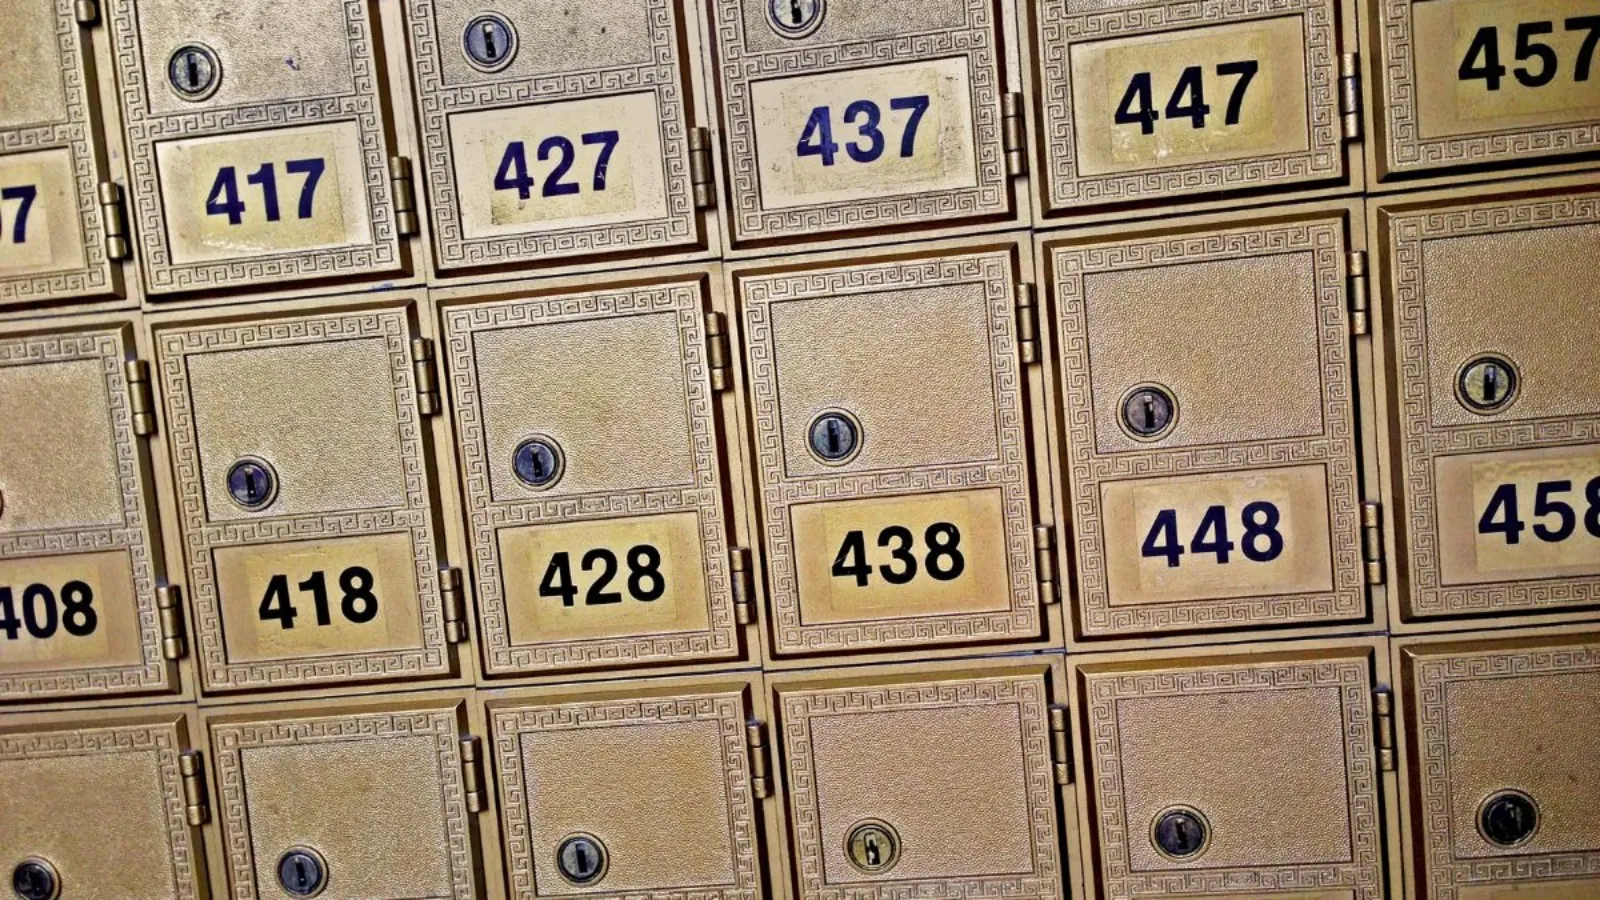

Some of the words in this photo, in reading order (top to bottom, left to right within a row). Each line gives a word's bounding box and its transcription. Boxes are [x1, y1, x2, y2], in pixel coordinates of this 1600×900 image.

[1458, 14, 1600, 91] 457
[1115, 60, 1259, 135] 447
[797, 96, 930, 167] 437
[206, 158, 324, 224] 417
[494, 131, 619, 199] 427
[0, 184, 37, 244] 7
[832, 523, 964, 586] 438
[1142, 502, 1283, 567] 448
[259, 566, 378, 629] 418
[539, 545, 665, 606] 428
[0, 580, 97, 640] 408
